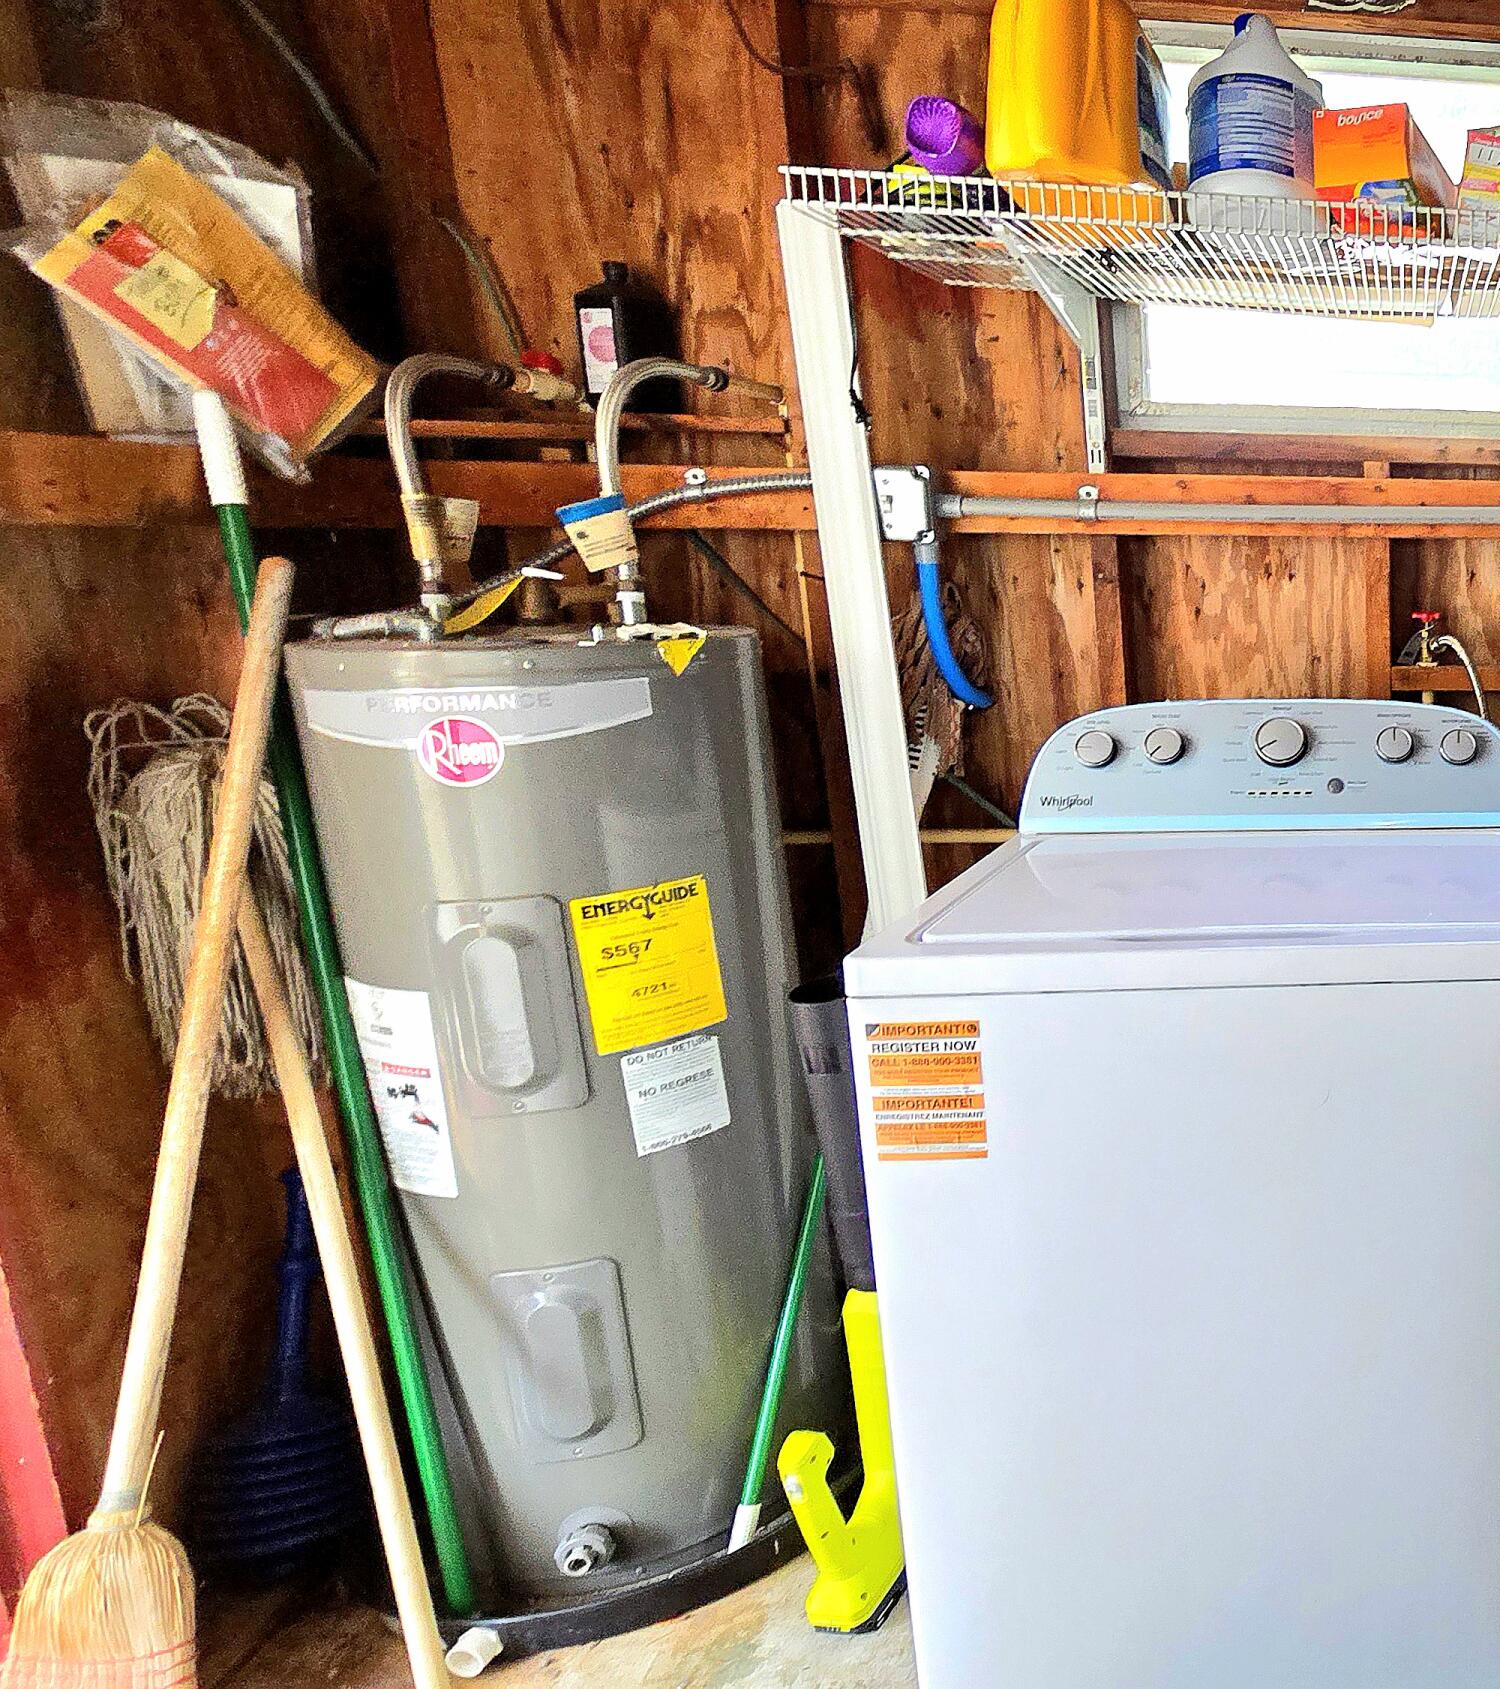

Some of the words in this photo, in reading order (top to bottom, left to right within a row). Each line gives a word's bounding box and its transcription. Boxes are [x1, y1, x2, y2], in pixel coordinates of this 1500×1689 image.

[1337, 109, 1384, 127] bounce
[425, 719, 498, 776] Rheem
[1040, 795, 1093, 810] Whirlpool
[882, 1023, 966, 1037] IMPORTANT!
[872, 1042, 940, 1053] REGISTER
[943, 1040, 977, 1051] NOW
[627, 1055, 644, 1066] DO
[647, 1047, 669, 1060] NOT
[638, 1087, 657, 1098] NO
